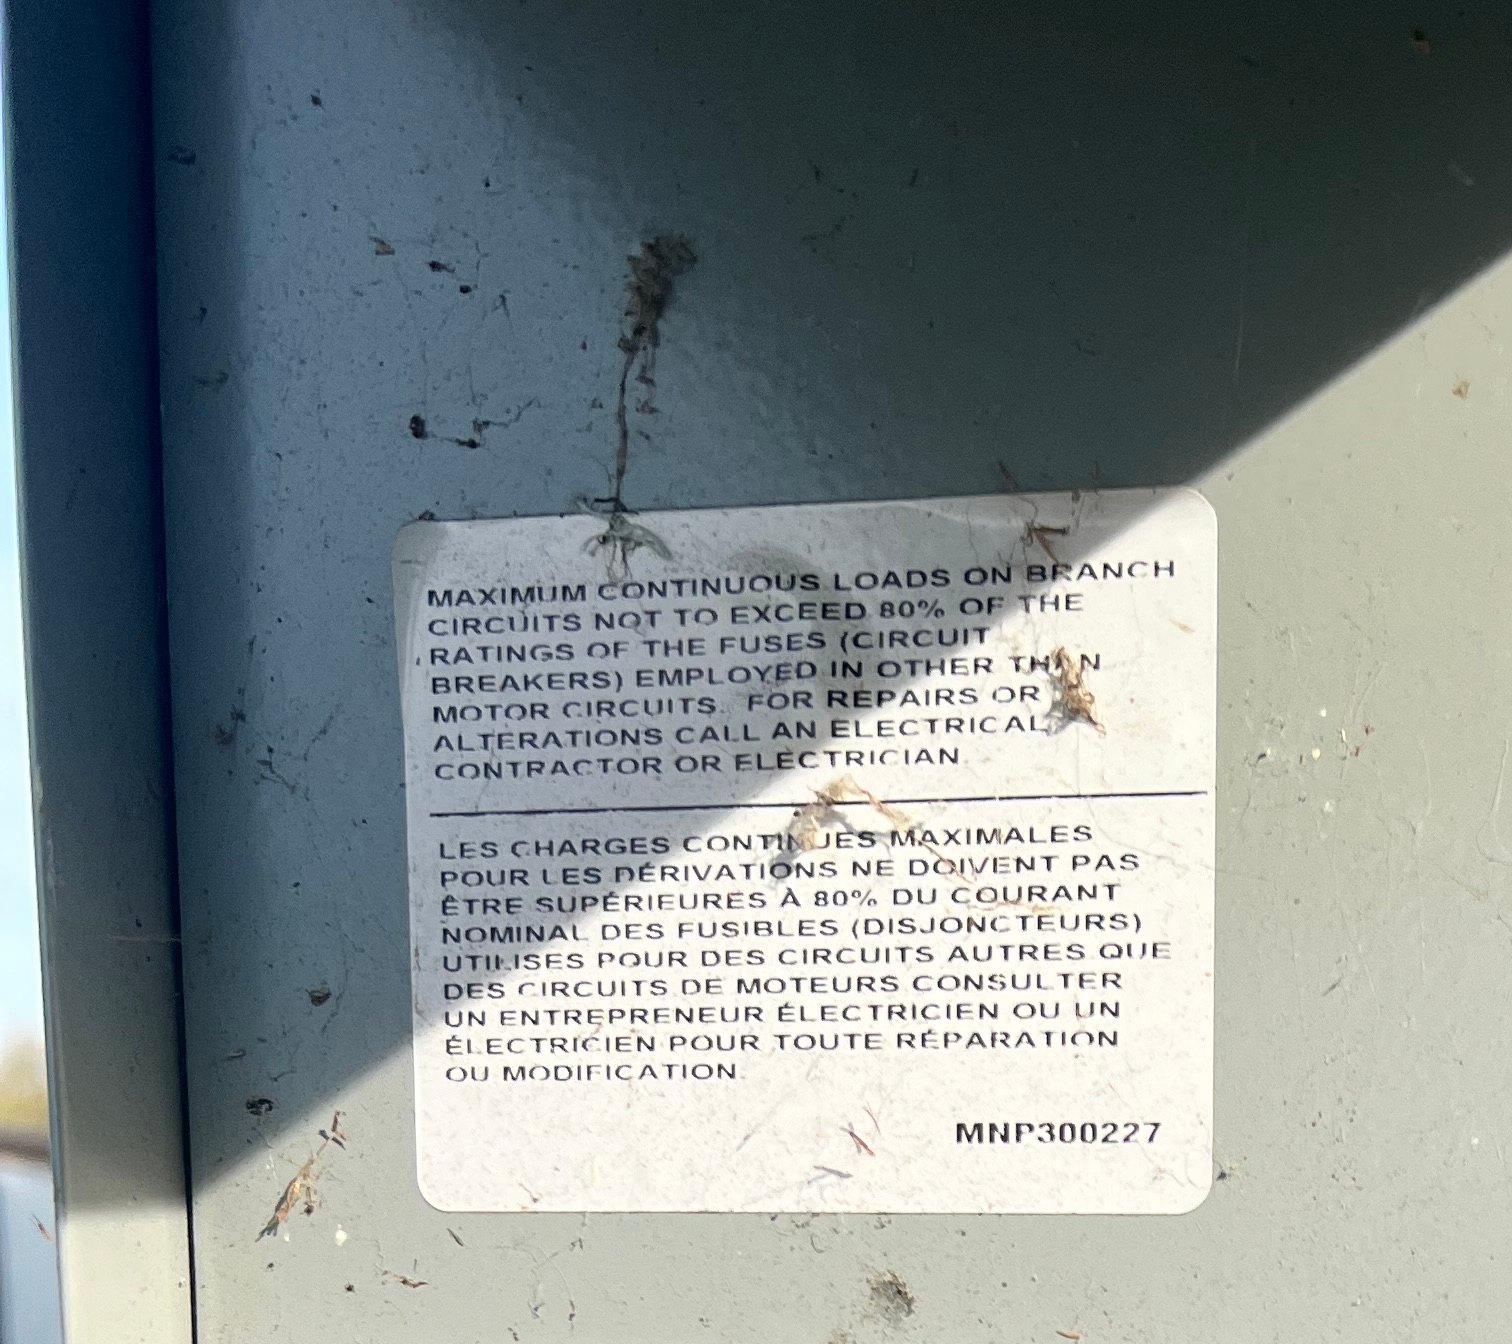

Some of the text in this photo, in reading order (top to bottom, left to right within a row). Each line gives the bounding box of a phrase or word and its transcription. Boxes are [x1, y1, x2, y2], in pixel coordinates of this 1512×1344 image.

[428, 560, 1174, 607] MAXIMUM CONTINUOUS LOADS ON BRANCH
[428, 593, 1083, 636] CIRCUITS NOT TO EXCEED 80% OF THE
[430, 626, 990, 665] RATINGS OF THE FUSES (CIRCUIT
[431, 671, 623, 695] BREAKERS)
[636, 661, 817, 687] EMPLOYED
[831, 661, 862, 678] IN
[876, 657, 993, 678] OTHER
[433, 703, 549, 723] MOTOR
[747, 691, 812, 711] FOR
[827, 688, 978, 709] REPAIRS
[991, 685, 1039, 703] OR
[433, 713, 1048, 752] ALTERATIONS CALL AN ELECTRICAL
[434, 757, 662, 780] CONTRACTOR
[674, 755, 721, 773] OR
[439, 841, 498, 859] LES
[510, 836, 670, 858] CHARGES
[890, 825, 1094, 848] MAXIMALES
[440, 853, 1139, 888] POUR LES DÉRIVATIONS NE DOIVENT PAS
[441, 883, 1121, 916] ÊTRE SUPÉRIEURES À 80% DU COURANT
[441, 913, 1142, 944] NOMINAL DES FUSIBLES (DISJONCTEURS)
[443, 941, 1171, 972] UTILISES POUR DES CIRCUITS AUTRES QUE
[443, 972, 1122, 1001] DES CIRCUITS DE MOTEURS CONSULTER
[442, 1001, 1120, 1028] UN ENTREPRENEUR ÉLECTRICIEN OU UN
[445, 1029, 1118, 1056] ÉLECTRICIEN POUR TOUTE RÉPARATION
[445, 1066, 489, 1082] OU
[956, 1122, 1161, 1144] MNP300227
